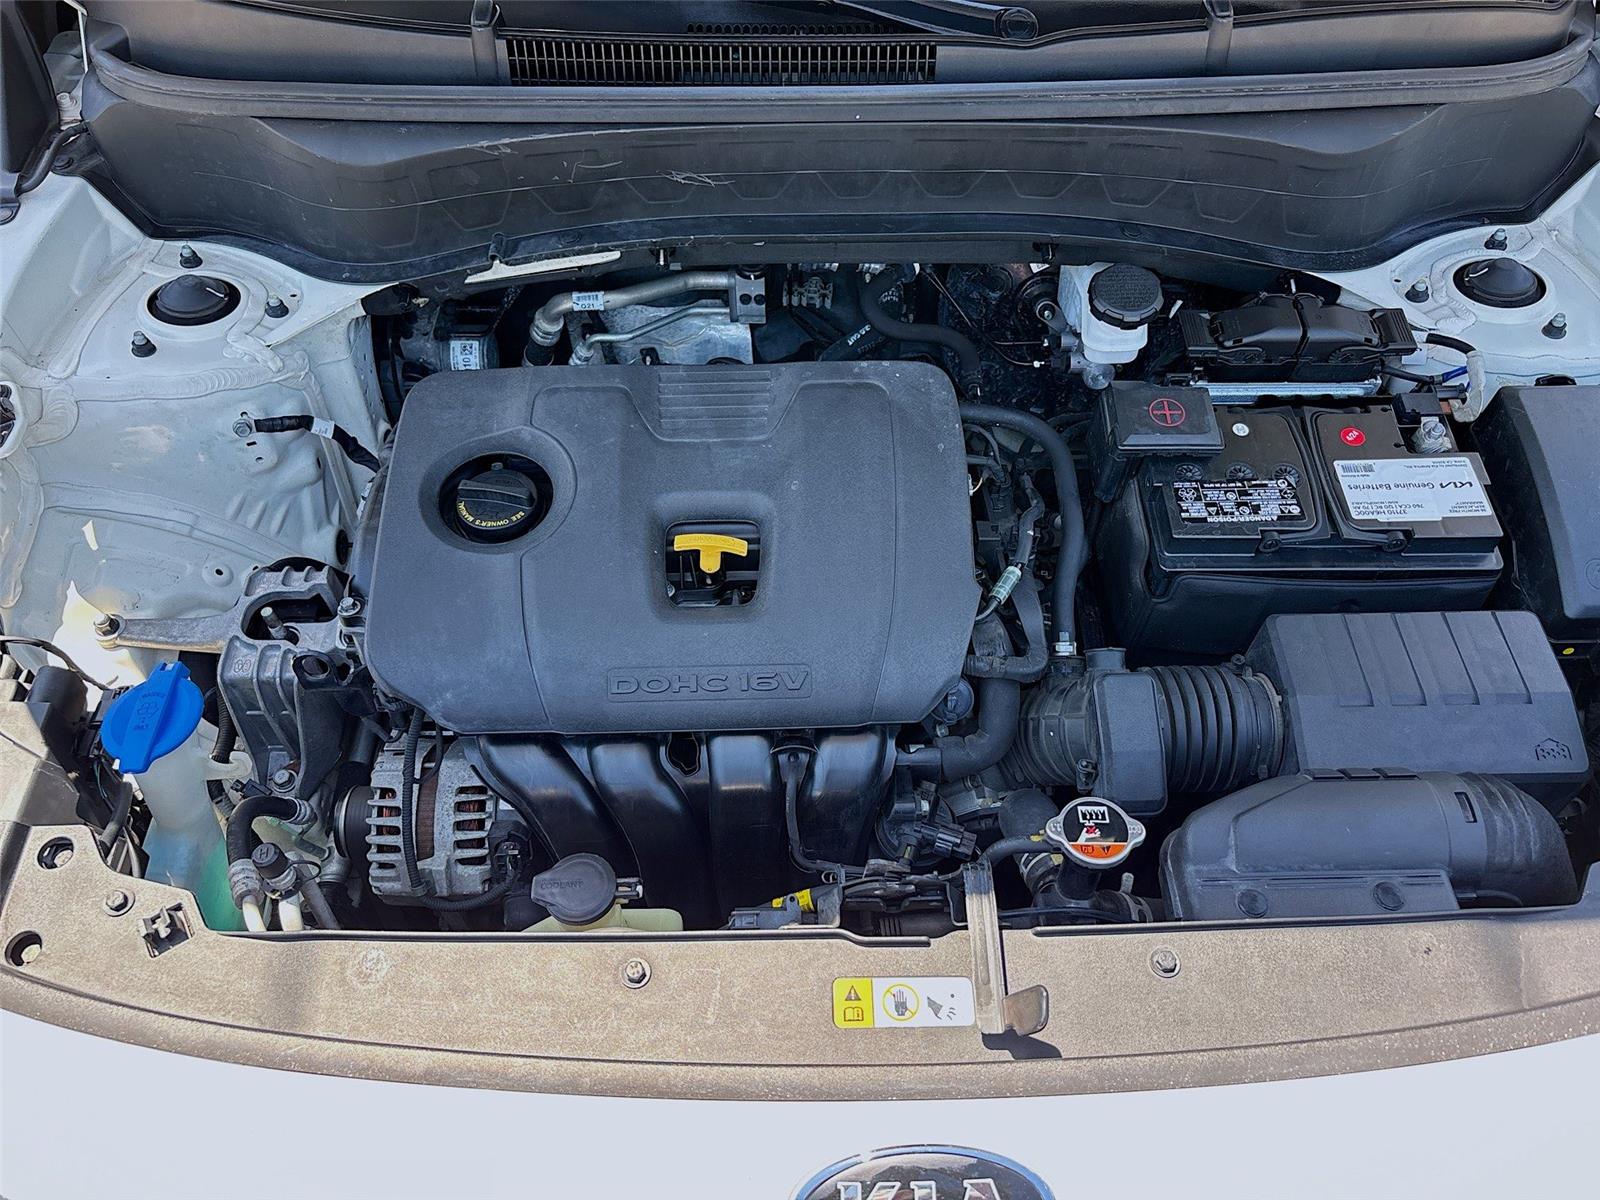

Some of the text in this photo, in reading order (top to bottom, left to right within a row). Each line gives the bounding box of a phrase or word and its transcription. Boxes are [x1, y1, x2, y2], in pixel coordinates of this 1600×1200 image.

[1347, 481, 1473, 492] KIA Genuine Batteries
[510, 511, 525, 522] SEE
[474, 519, 510, 527] OWNER'S
[610, 671, 809, 694] DOHC 16V
